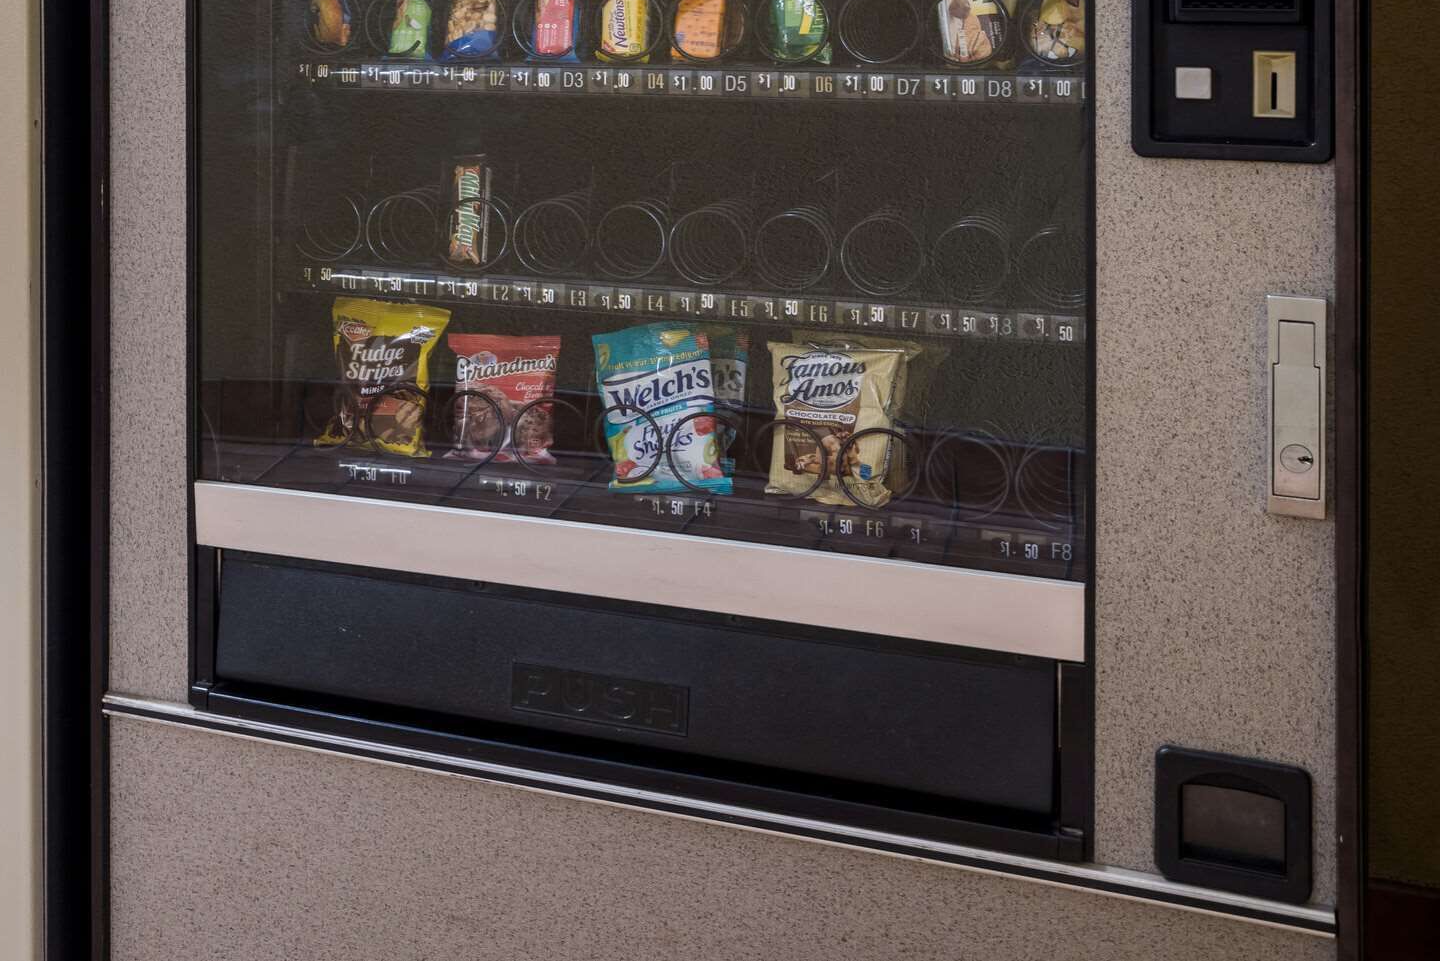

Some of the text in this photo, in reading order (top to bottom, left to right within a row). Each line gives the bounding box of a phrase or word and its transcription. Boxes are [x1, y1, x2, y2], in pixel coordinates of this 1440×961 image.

[616, 0, 628, 49] Newtons
[564, 72, 583, 88] D3
[648, 73, 664, 89] D4
[726, 76, 747, 91] D5
[816, 76, 832, 92] D6
[897, 79, 920, 95] D7
[988, 81, 1012, 97] D8
[571, 290, 586, 306] E3
[648, 295, 663, 311] E4
[731, 300, 748, 316] E5
[810, 305, 828, 322] E6
[902, 311, 919, 328] E7
[350, 343, 405, 366] Fudge
[346, 361, 405, 384] Stripes
[456, 353, 557, 383] Grandma's
[779, 355, 867, 386] Famous
[608, 366, 710, 417] Welch's
[780, 379, 859, 403] Amos
[789, 410, 838, 420] CHOCOLATE
[536, 485, 552, 501] F2
[867, 520, 884, 538] F6
[1051, 542, 1072, 560] F8
